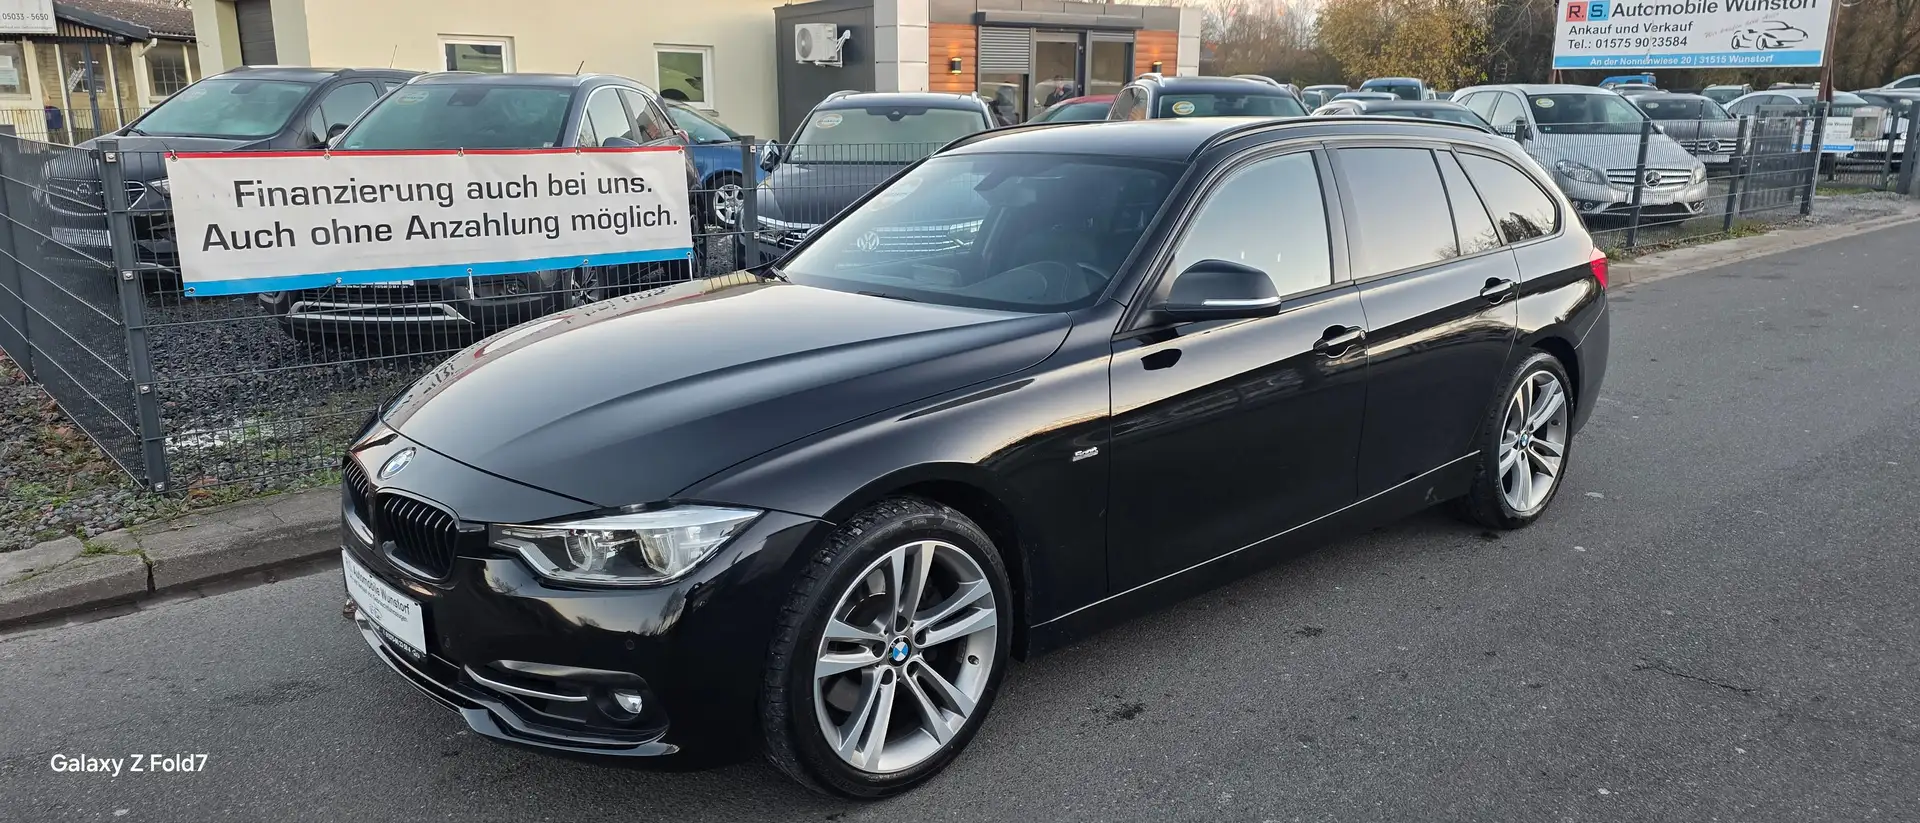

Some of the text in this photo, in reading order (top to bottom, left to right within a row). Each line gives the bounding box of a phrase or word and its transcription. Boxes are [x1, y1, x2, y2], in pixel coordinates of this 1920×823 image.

[1568, 5, 1585, 18] R.
[1590, 4, 1607, 18] S.
[1612, 0, 1718, 17] Automobile
[1568, 21, 1694, 35] Ankauf und Verkauf
[1568, 36, 1688, 49] Tel.: 01575 9023584
[1681, 56, 1692, 64] 20
[1698, 55, 1727, 63] 31515
[1728, 54, 1775, 63] Wunstorf
[232, 171, 653, 208] Finanzierung auch bei uns.
[202, 204, 679, 252] Auch ohne Anzahlung möglich.
[380, 586, 411, 615] Wunstorf
